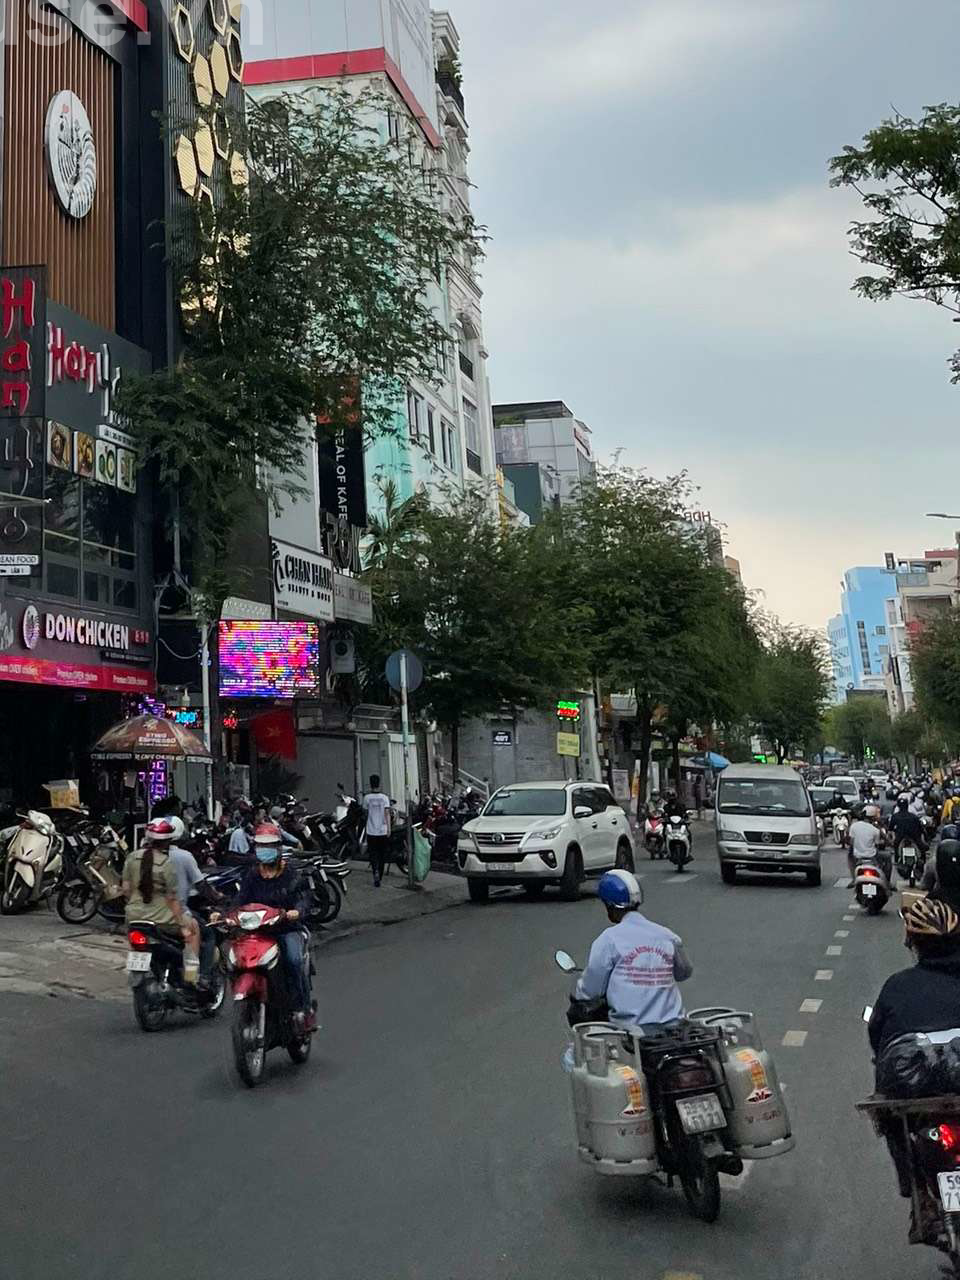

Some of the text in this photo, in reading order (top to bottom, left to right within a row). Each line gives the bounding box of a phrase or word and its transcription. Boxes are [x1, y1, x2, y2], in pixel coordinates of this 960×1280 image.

[336, 464, 346, 483] OF
[337, 487, 348, 521] KAFE
[16, 554, 37, 563] FOOD
[45, 613, 76, 643] DON
[76, 617, 129, 650] CHICKEN
